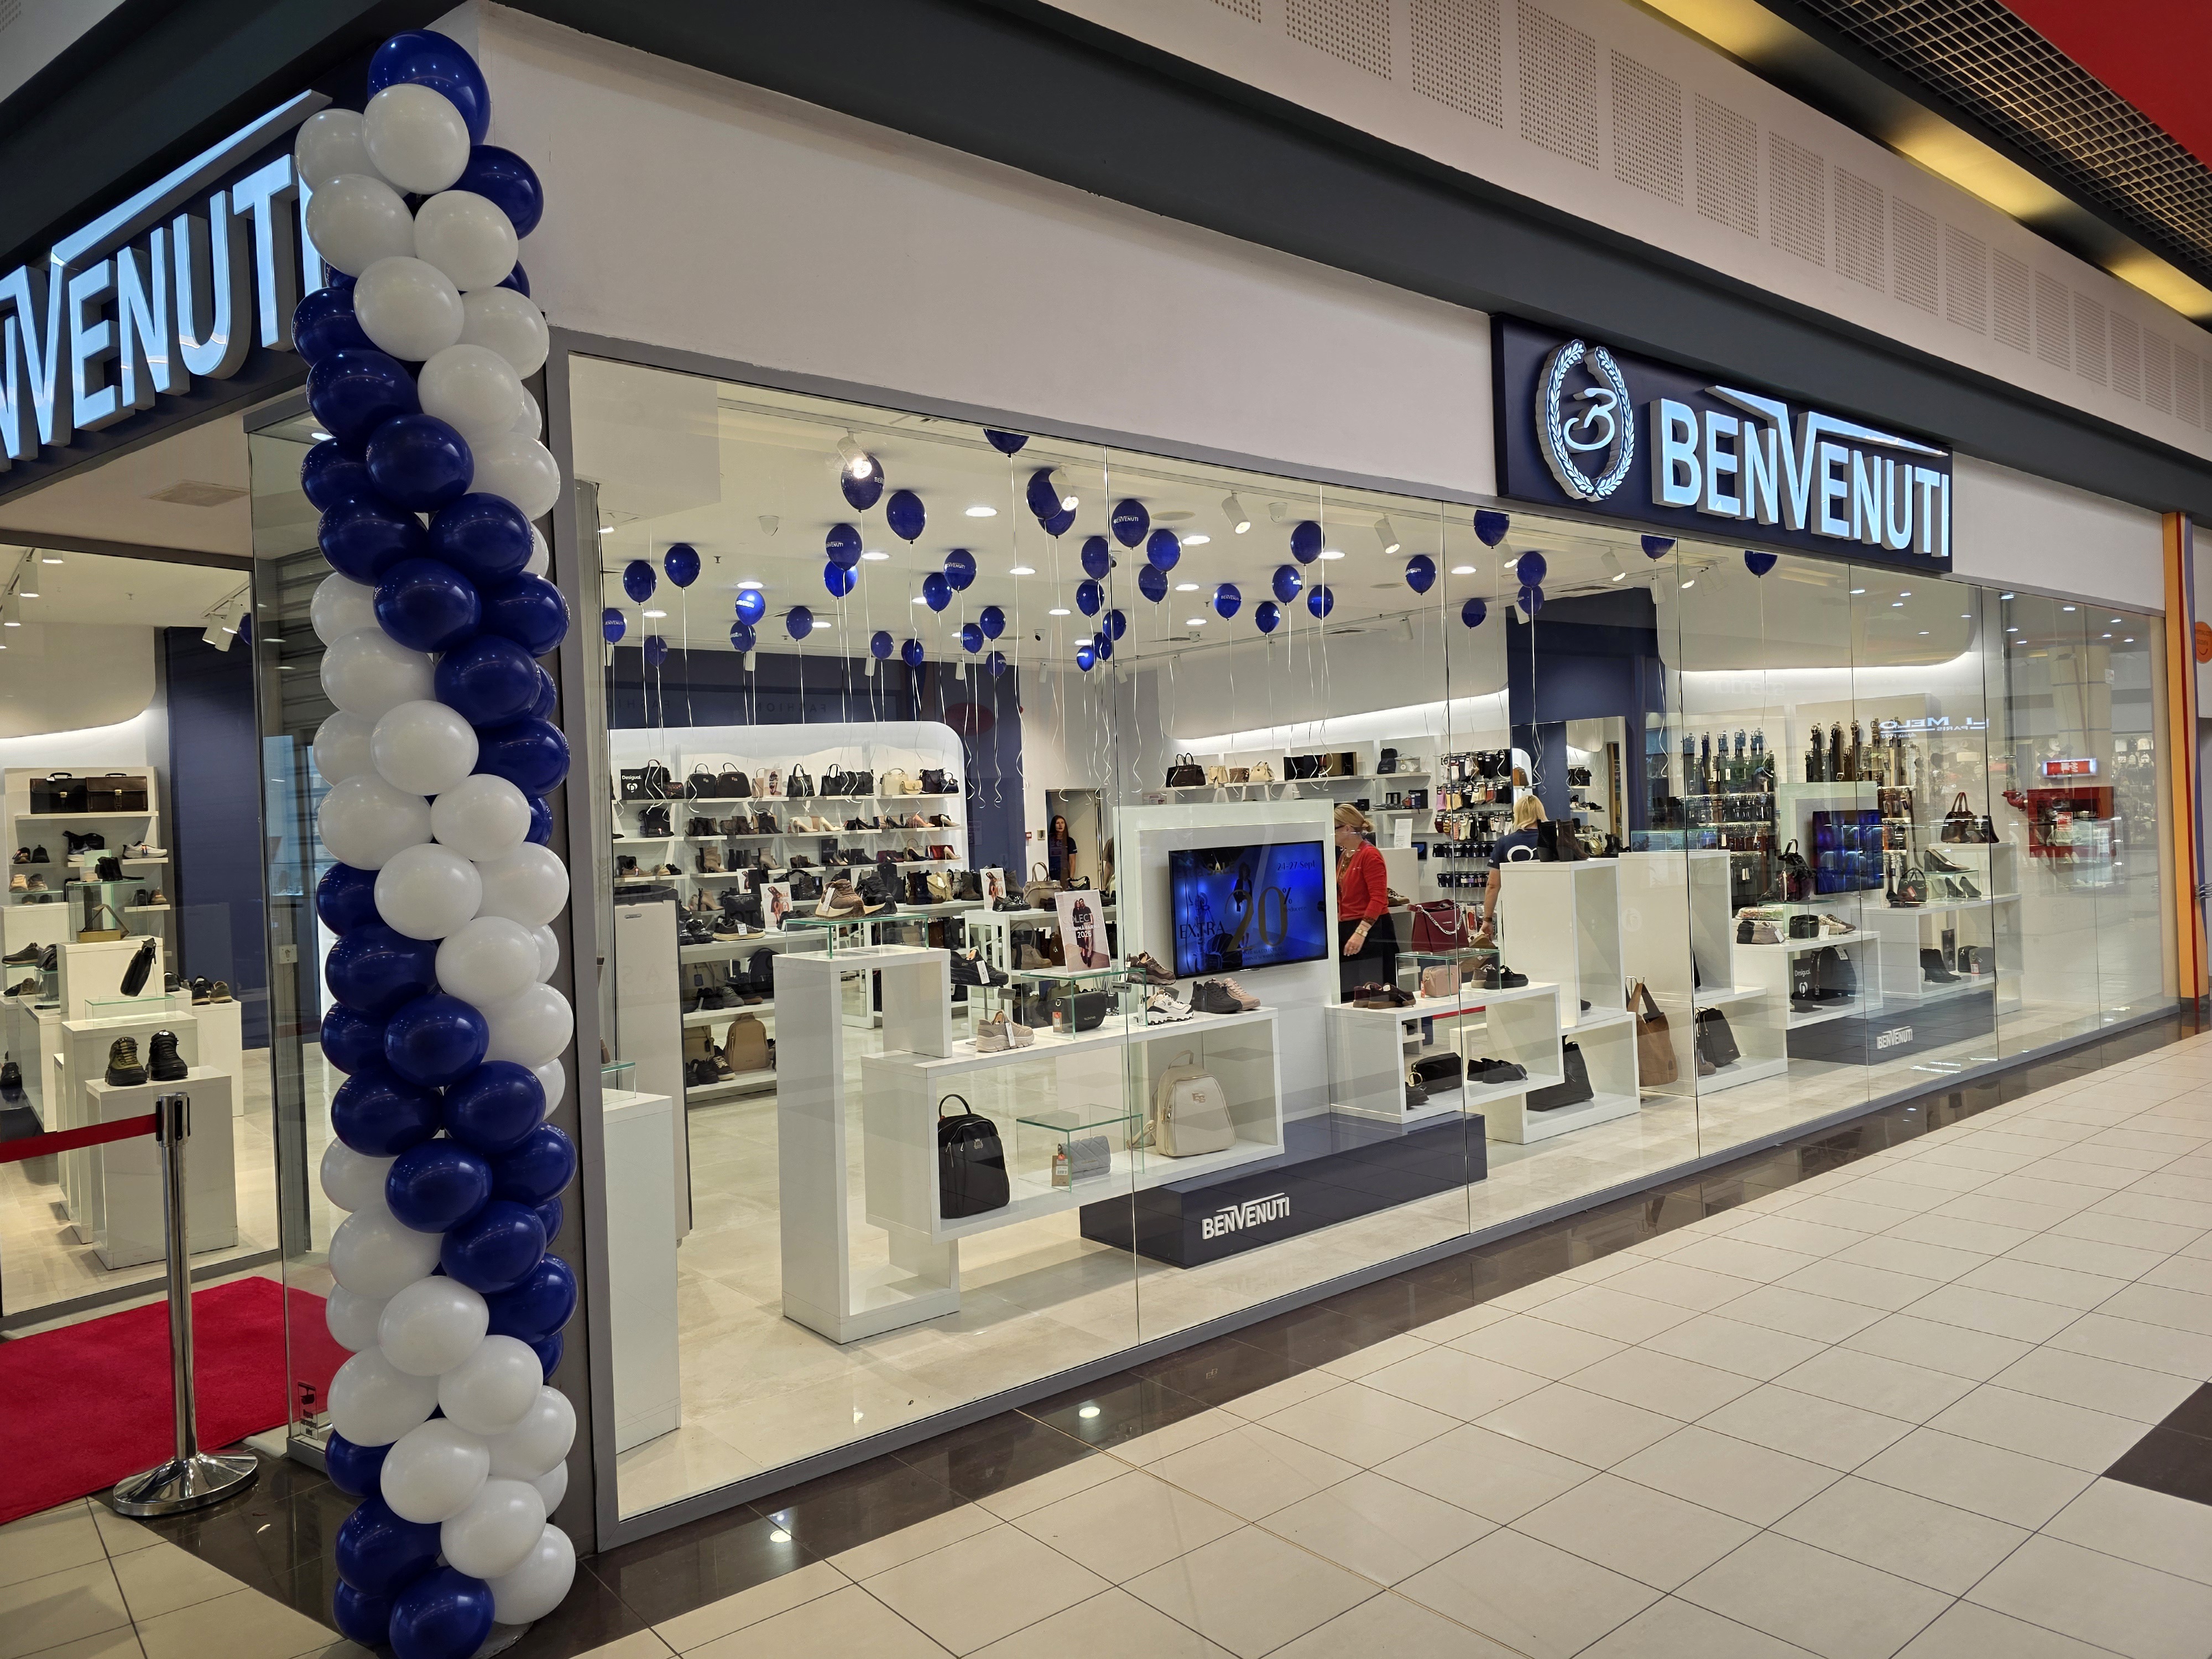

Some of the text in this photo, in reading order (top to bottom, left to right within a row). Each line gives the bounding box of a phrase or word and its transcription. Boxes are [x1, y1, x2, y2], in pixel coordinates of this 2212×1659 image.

[1652, 385, 1950, 557] BENVENUTI
[1180, 920, 1225, 940] EXTRA
[1876, 1026, 1913, 1050] BENVENUTI
[1202, 1192, 1290, 1240] BENVENUTI
